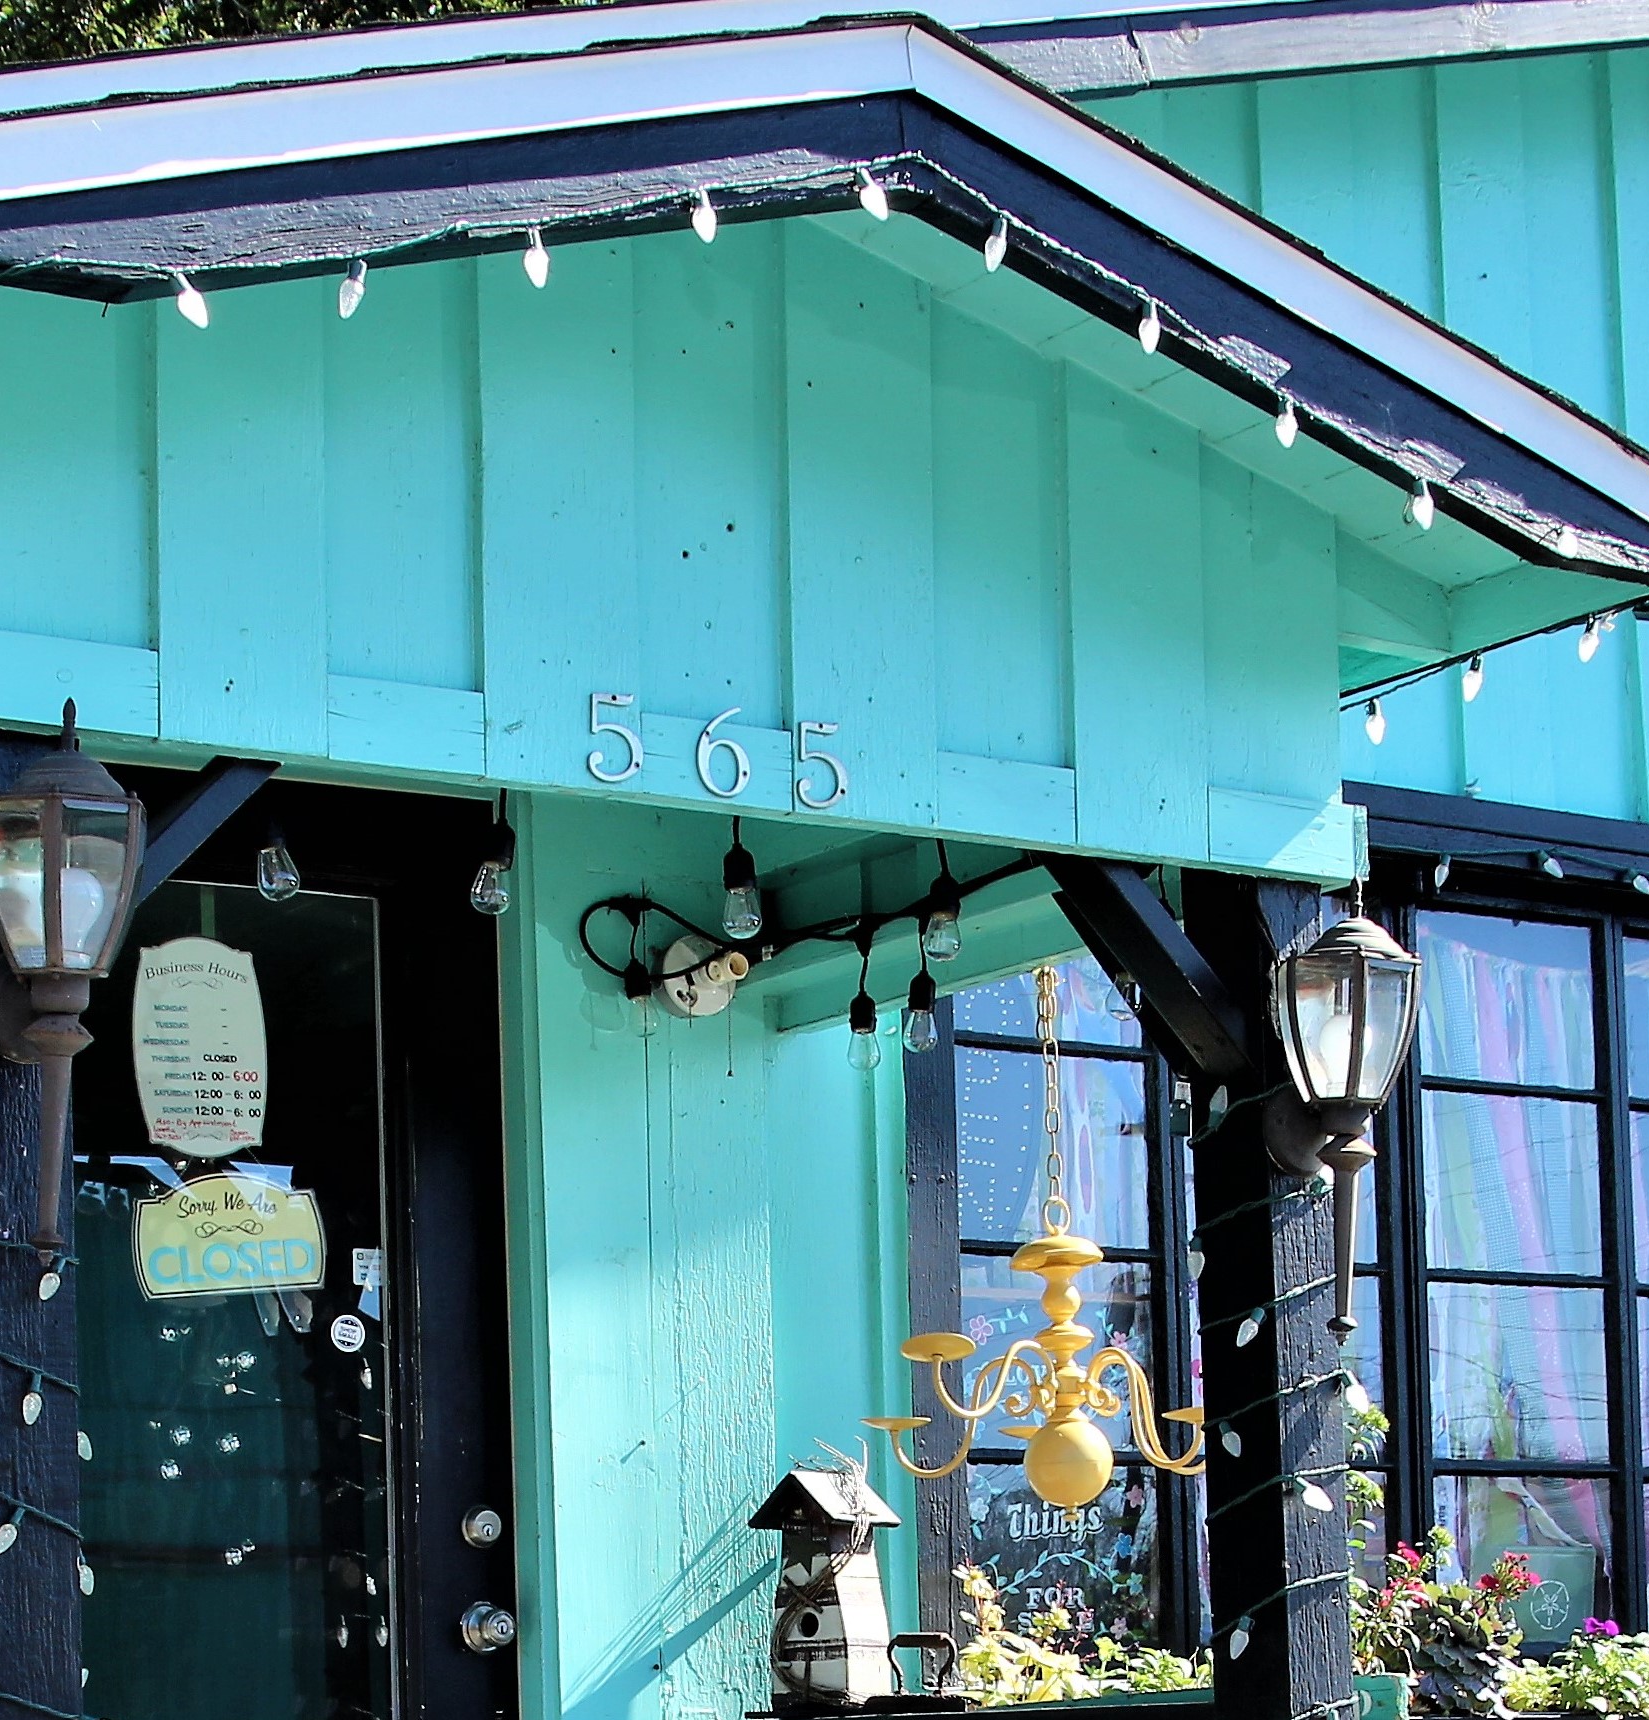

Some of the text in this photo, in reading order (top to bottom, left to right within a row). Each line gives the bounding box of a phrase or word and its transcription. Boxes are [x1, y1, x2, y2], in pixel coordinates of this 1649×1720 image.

[587, 692, 849, 810] 565
[145, 962, 248, 983] Business Hours
[203, 1054, 237, 1063] CLOSED
[233, 1070, 258, 1082] 6:00
[195, 1089, 223, 1099] 12:00
[195, 1106, 224, 1116] 12:00
[224, 1192, 245, 1210] We
[248, 1192, 277, 1215] Are
[149, 1238, 315, 1285] CLOSED
[1007, 1500, 1104, 1542] Things
[1025, 1587, 1086, 1610] FOR
